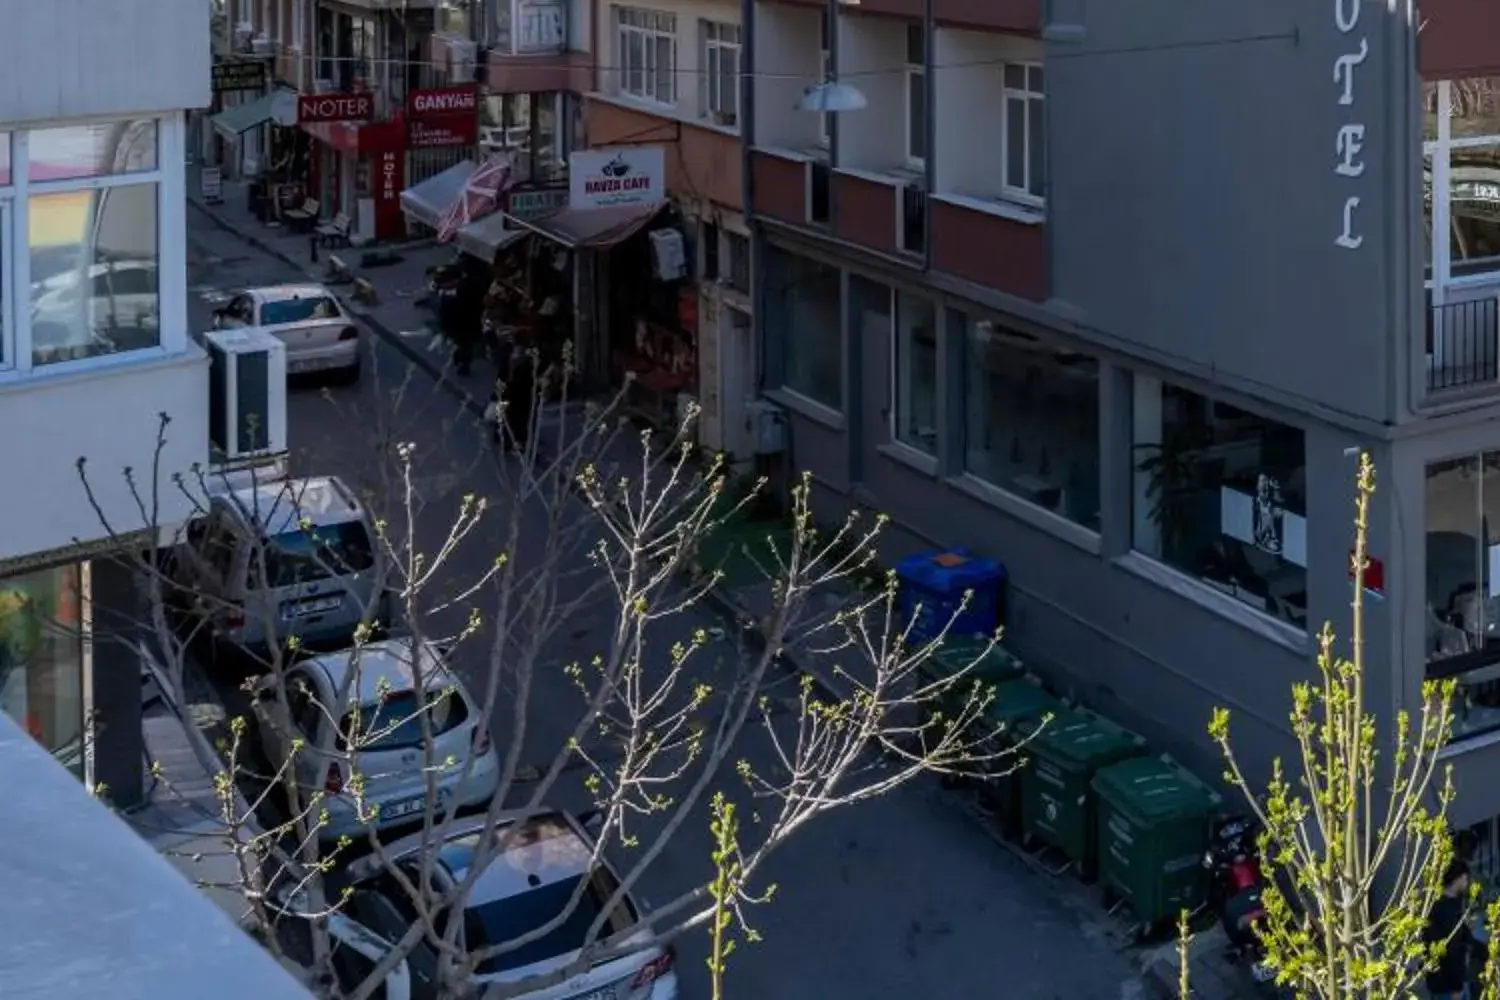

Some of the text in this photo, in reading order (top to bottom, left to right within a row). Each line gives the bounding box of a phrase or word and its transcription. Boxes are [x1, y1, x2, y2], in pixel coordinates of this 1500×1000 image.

[302, 99, 369, 118] NOTER
[383, 152, 396, 199] NOTER
[623, 176, 650, 191] CAFE
